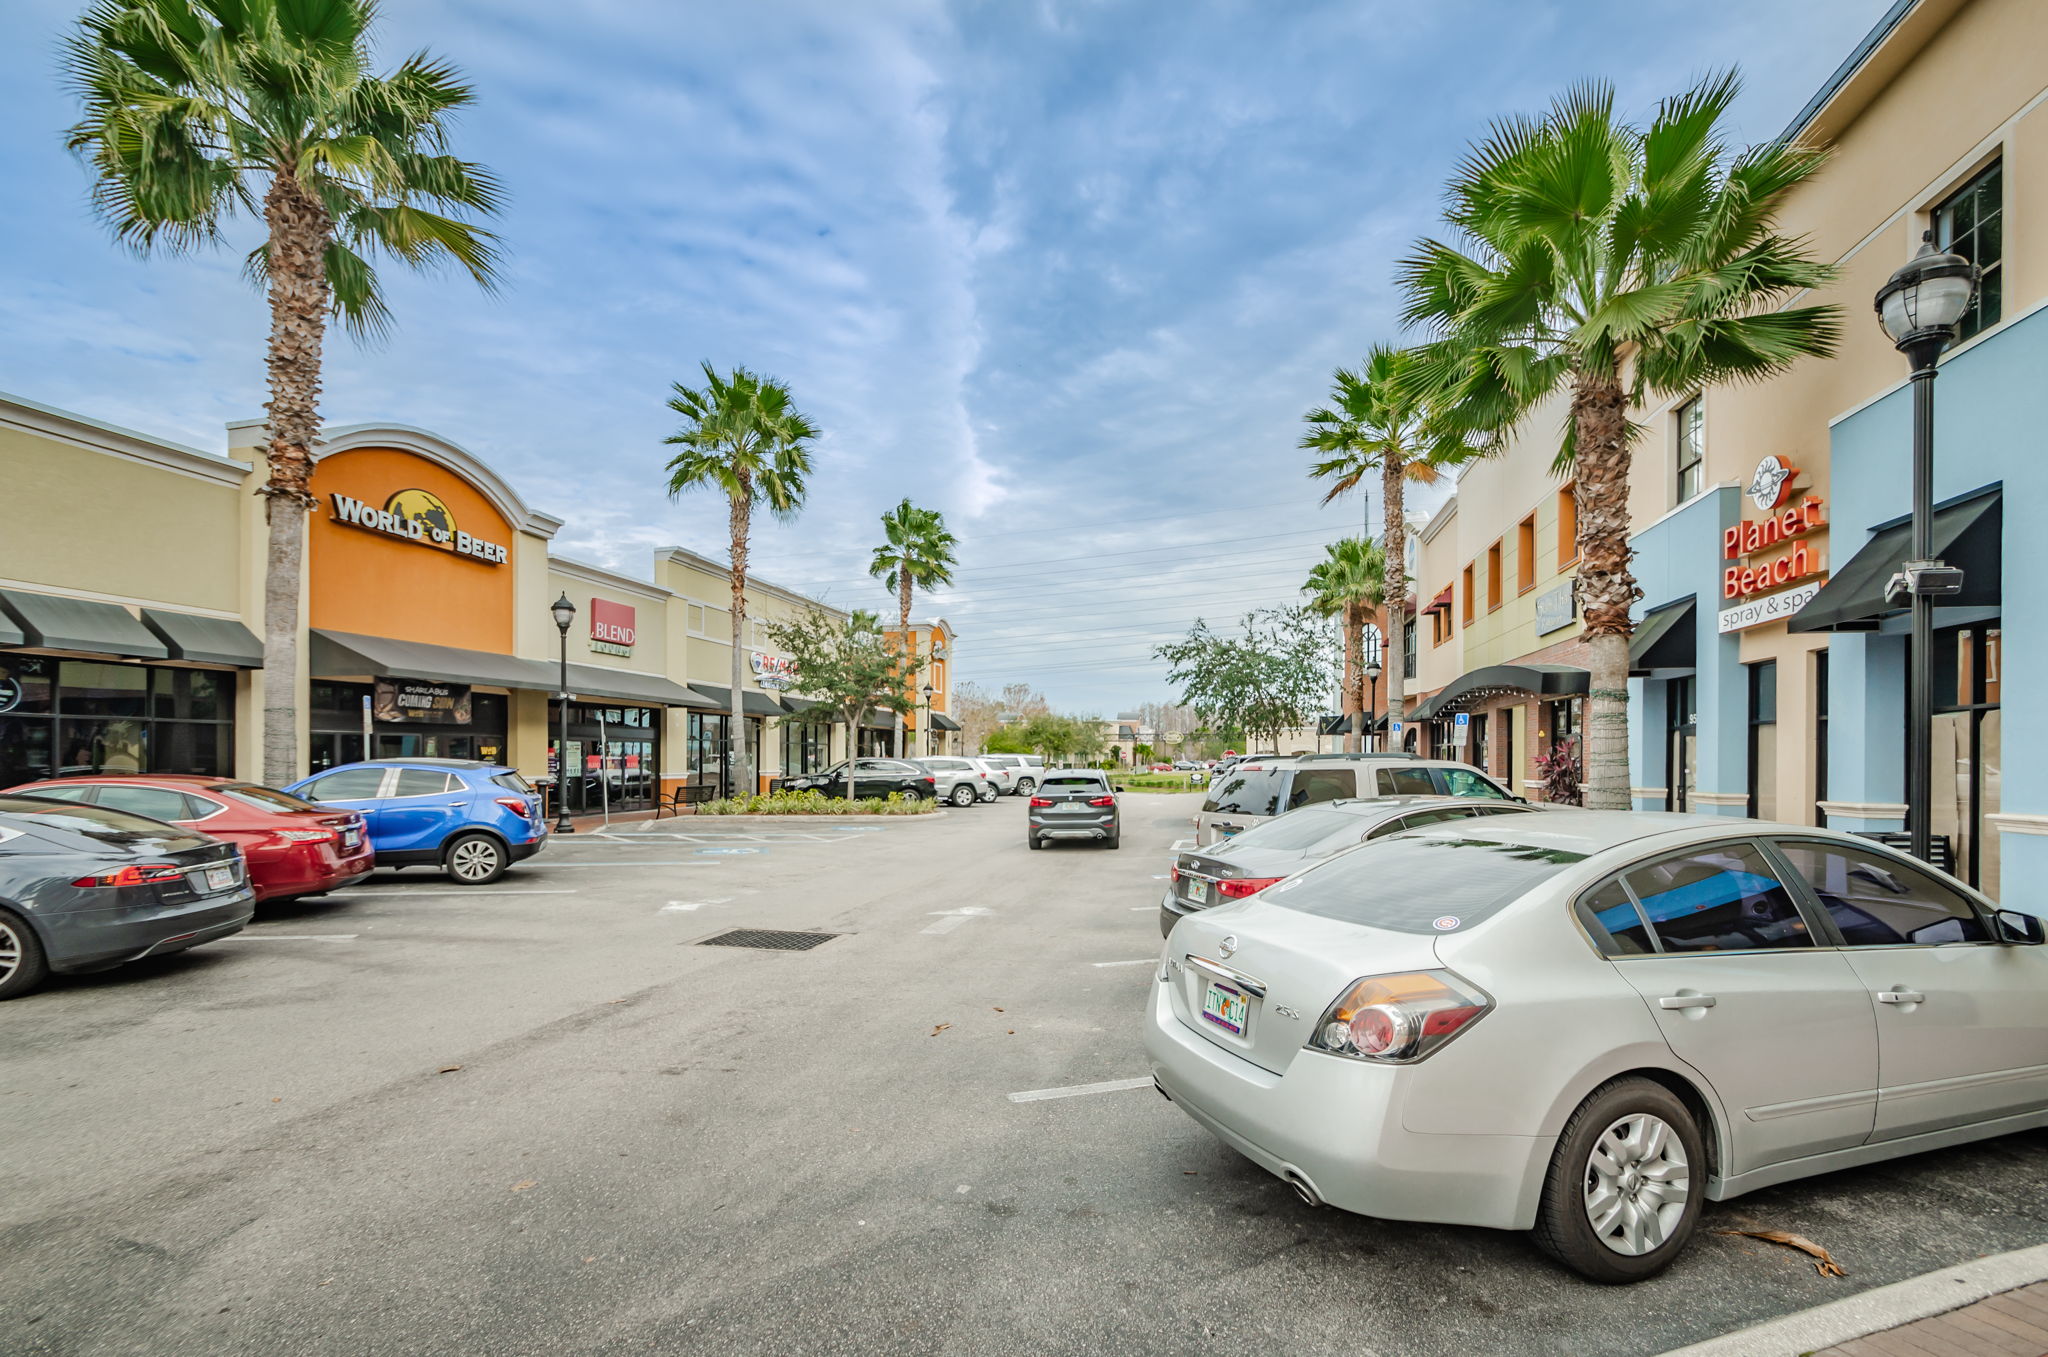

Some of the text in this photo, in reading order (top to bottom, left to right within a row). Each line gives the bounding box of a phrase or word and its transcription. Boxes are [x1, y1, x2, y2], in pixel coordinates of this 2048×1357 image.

[333, 493, 508, 564] WORLD OF BEER
[1724, 496, 1816, 560] Planet
[1724, 540, 1810, 600] Beach
[596, 622, 635, 644] BLEND
[1723, 590, 1814, 628] spray & spa
[397, 693, 433, 709] COMING
